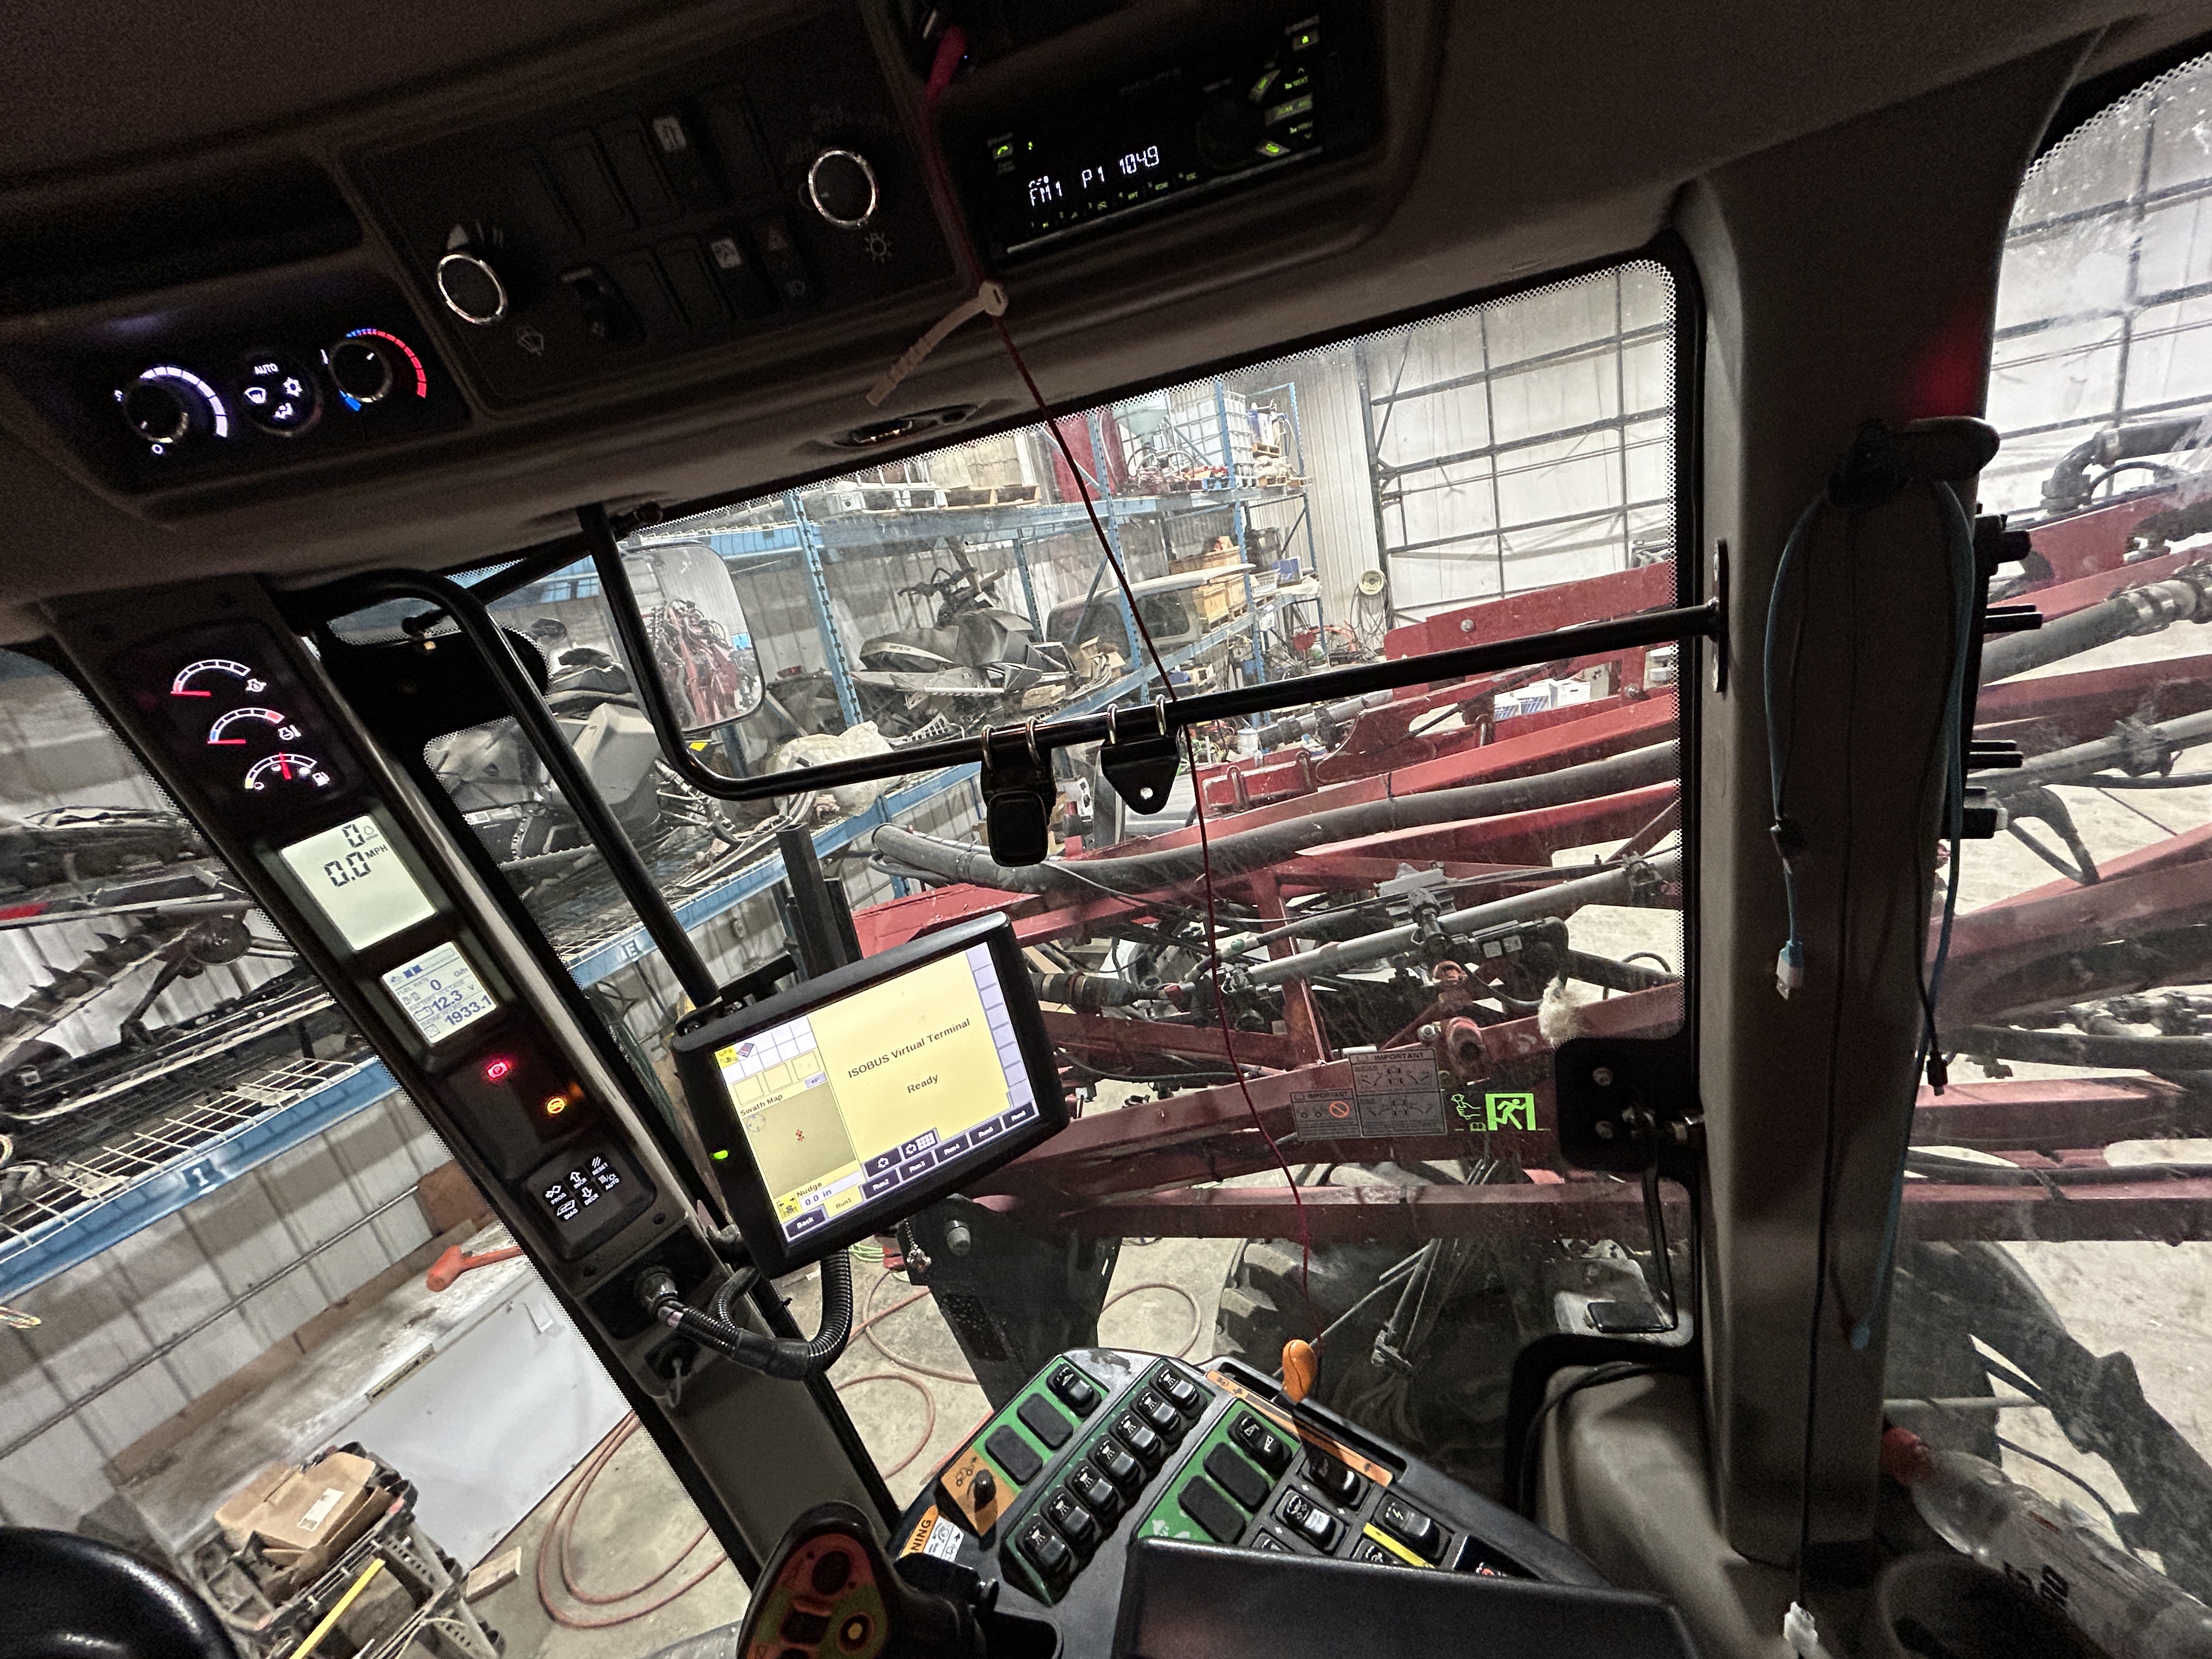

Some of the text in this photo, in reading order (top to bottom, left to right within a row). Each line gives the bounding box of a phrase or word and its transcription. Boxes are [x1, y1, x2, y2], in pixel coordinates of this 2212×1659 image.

[254, 363, 279, 375] AUTO
[342, 823, 365, 848] 0
[324, 844, 389, 887] 0.0 MPH
[430, 979, 442, 991] 0
[432, 990, 463, 1011] 12.3
[445, 995, 492, 1025] 1933.1
[719, 1048, 733, 1057] GPS
[848, 1018, 970, 1079] ISOBUS Virtual Terminal
[1374, 1052, 1424, 1060] IMPORTANT
[907, 1074, 939, 1093] Ready
[1307, 1091, 1348, 1099] IMPORTANT
[740, 1094, 783, 1116] Swath Map
[978, 1126, 994, 1138] Run5
[944, 1143, 960, 1155] Run4
[592, 1162, 608, 1176] RESET
[909, 1160, 926, 1173] Run3
[193, 1167, 210, 1187] 1
[573, 1177, 588, 1189] INCR
[605, 1178, 620, 1190] AUTO
[797, 1181, 822, 1197] Nudge
[872, 1178, 890, 1192] Run2
[550, 1192, 567, 1205] PROG
[584, 1193, 599, 1206] DECR
[805, 1188, 832, 1206] 0.0 in
[835, 1197, 852, 1210] Run1
[563, 1208, 579, 1220] DIAG
[796, 1216, 815, 1229] Back
